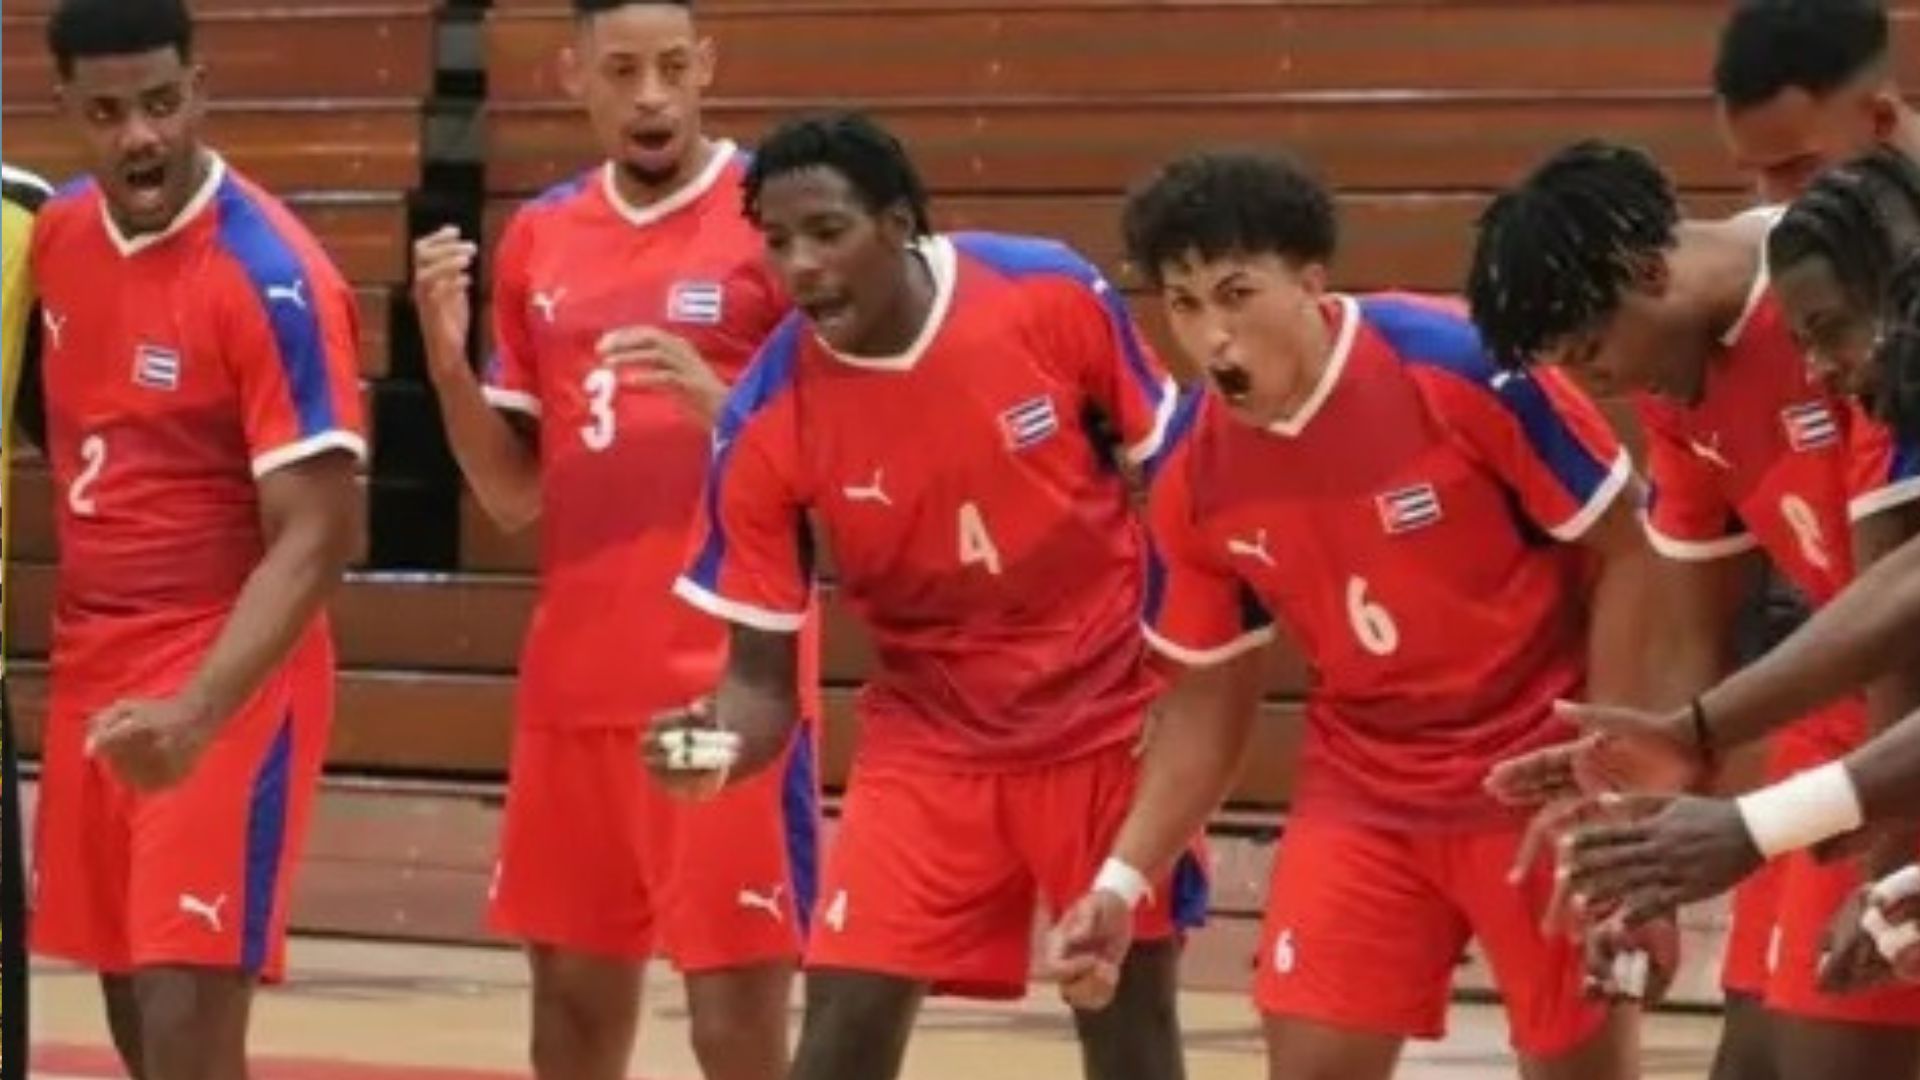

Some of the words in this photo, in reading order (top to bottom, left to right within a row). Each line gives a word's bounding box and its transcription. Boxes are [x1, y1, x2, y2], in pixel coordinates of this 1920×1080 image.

[581, 368, 619, 450] 3
[69, 436, 105, 513] 2
[960, 503, 999, 574] 4
[1347, 577, 1398, 655] 6
[825, 889, 847, 932] 4
[1273, 929, 1295, 973] 6
